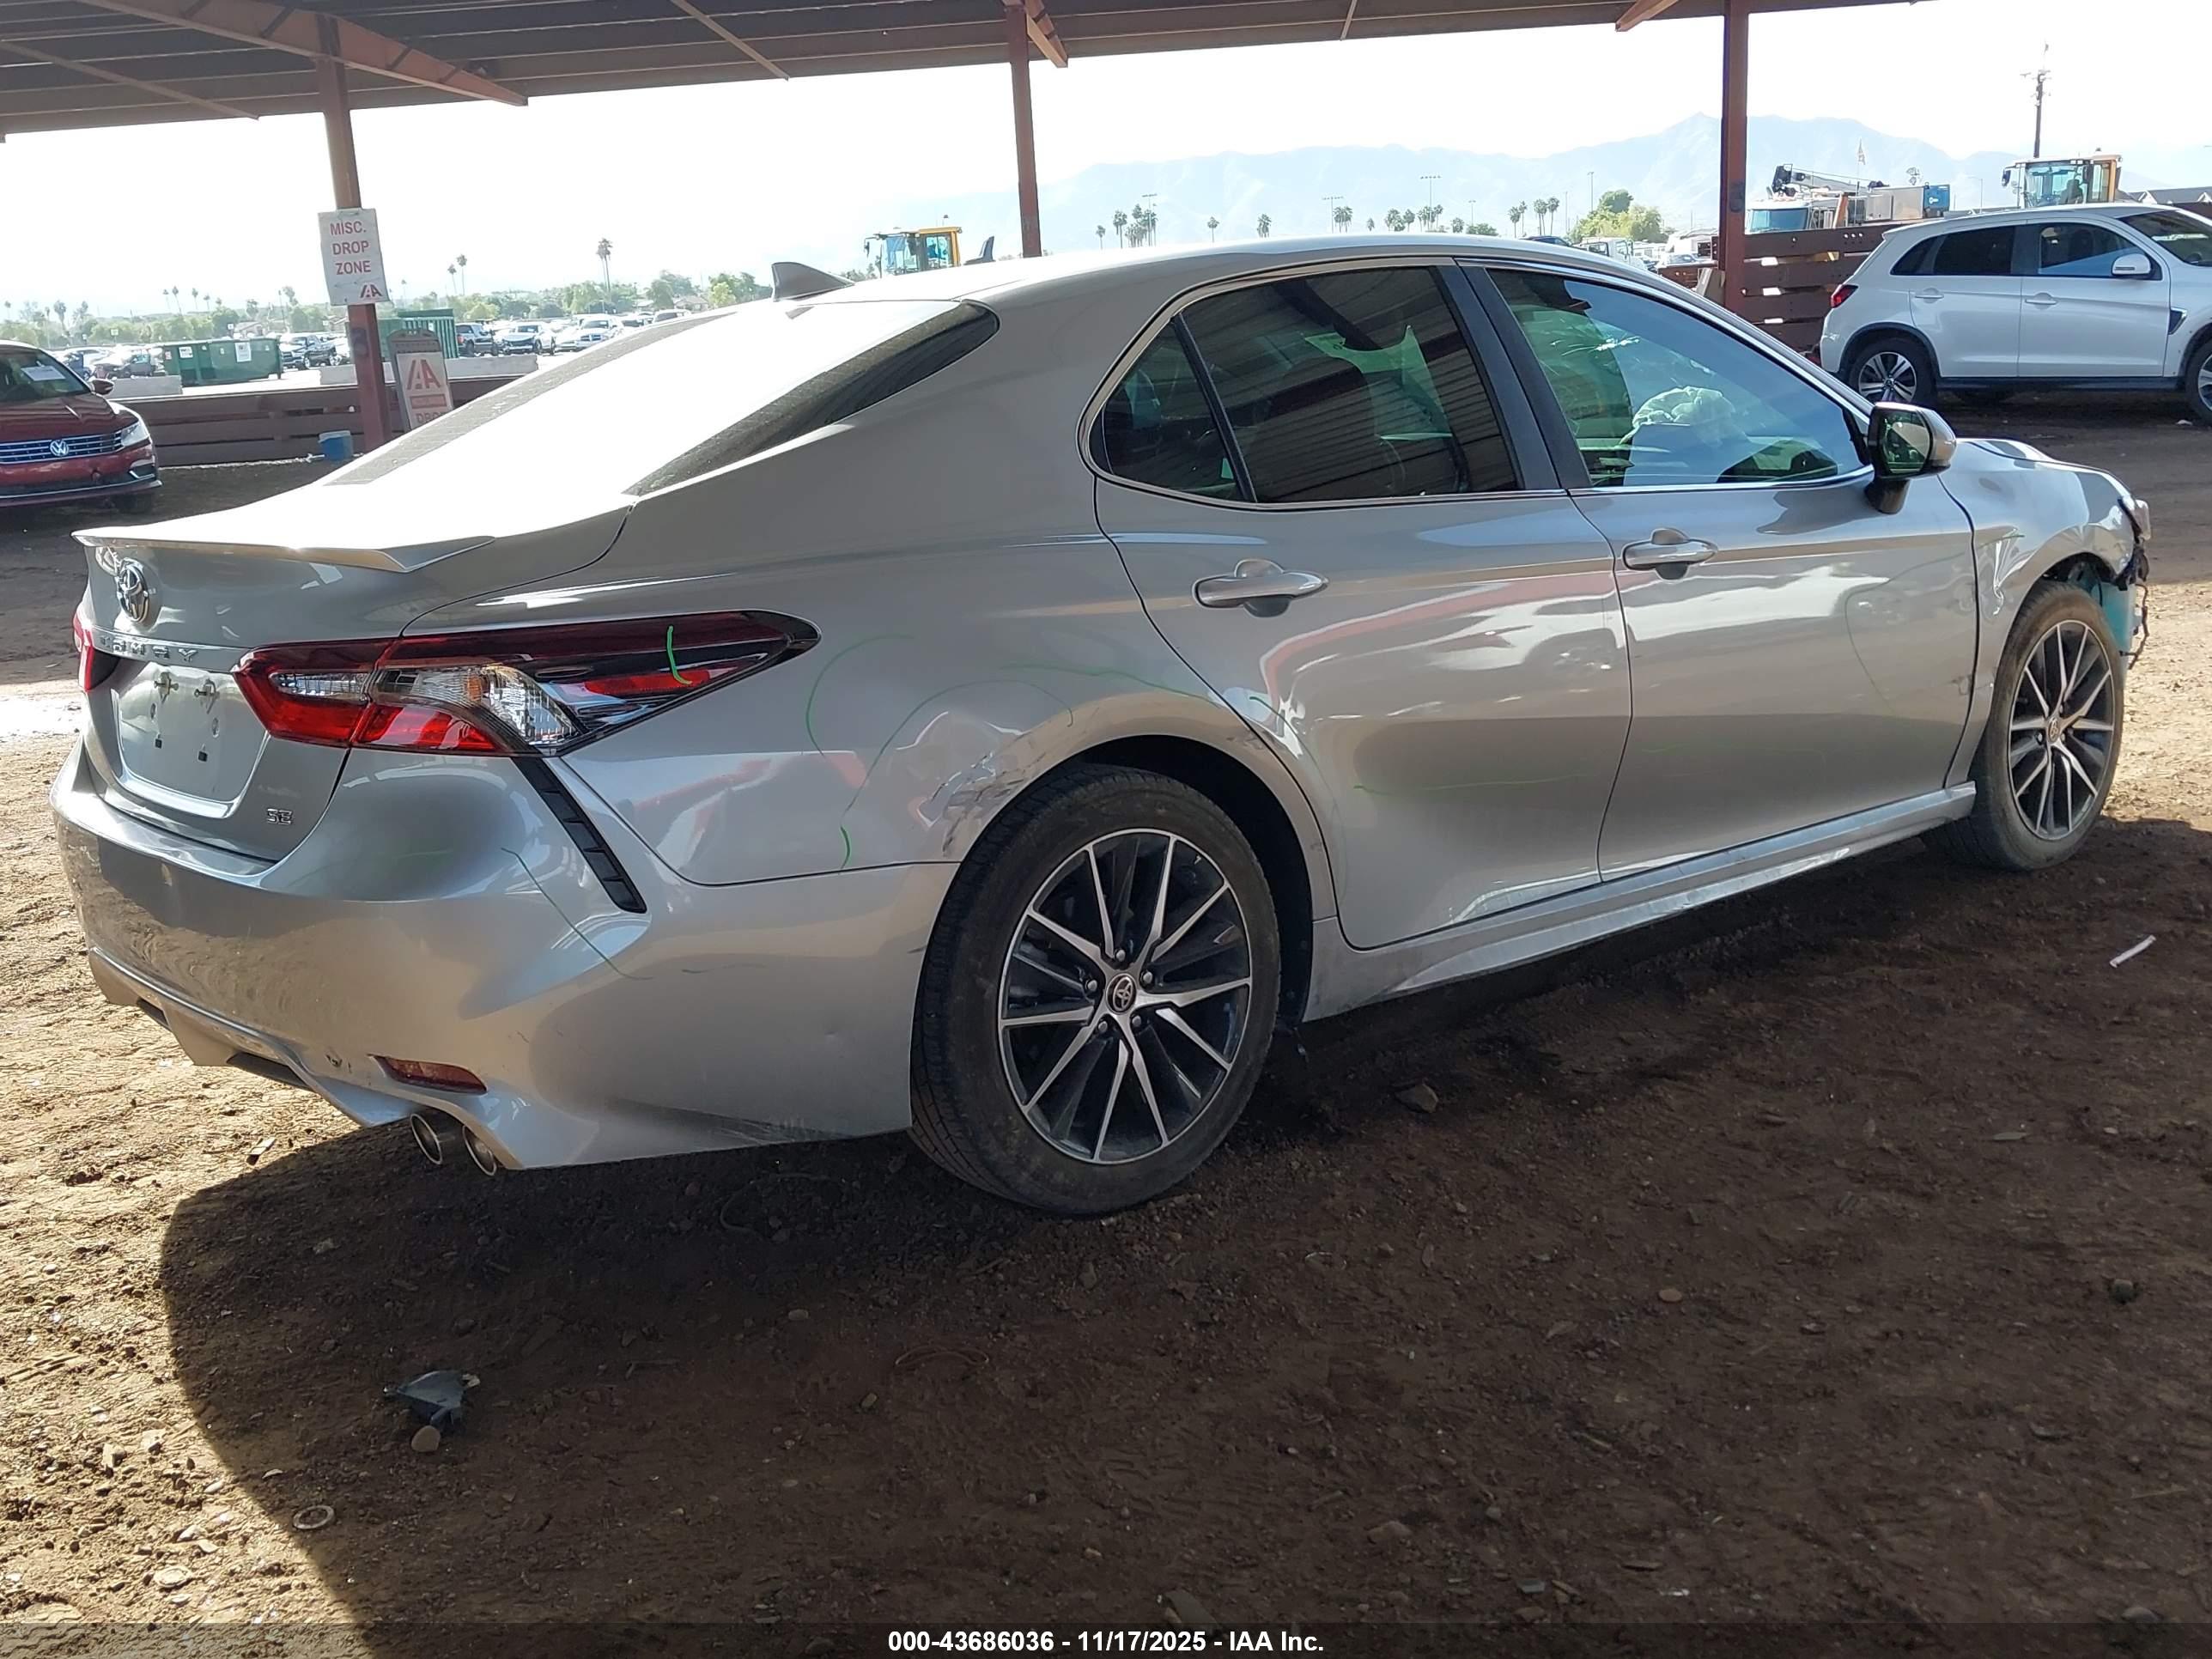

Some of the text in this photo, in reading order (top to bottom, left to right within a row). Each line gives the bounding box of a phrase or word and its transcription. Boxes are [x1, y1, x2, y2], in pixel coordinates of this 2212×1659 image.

[330, 221, 367, 236] MISC.
[332, 240, 369, 255] DROP
[335, 260, 372, 276] ZONE
[266, 807, 293, 825] SE
